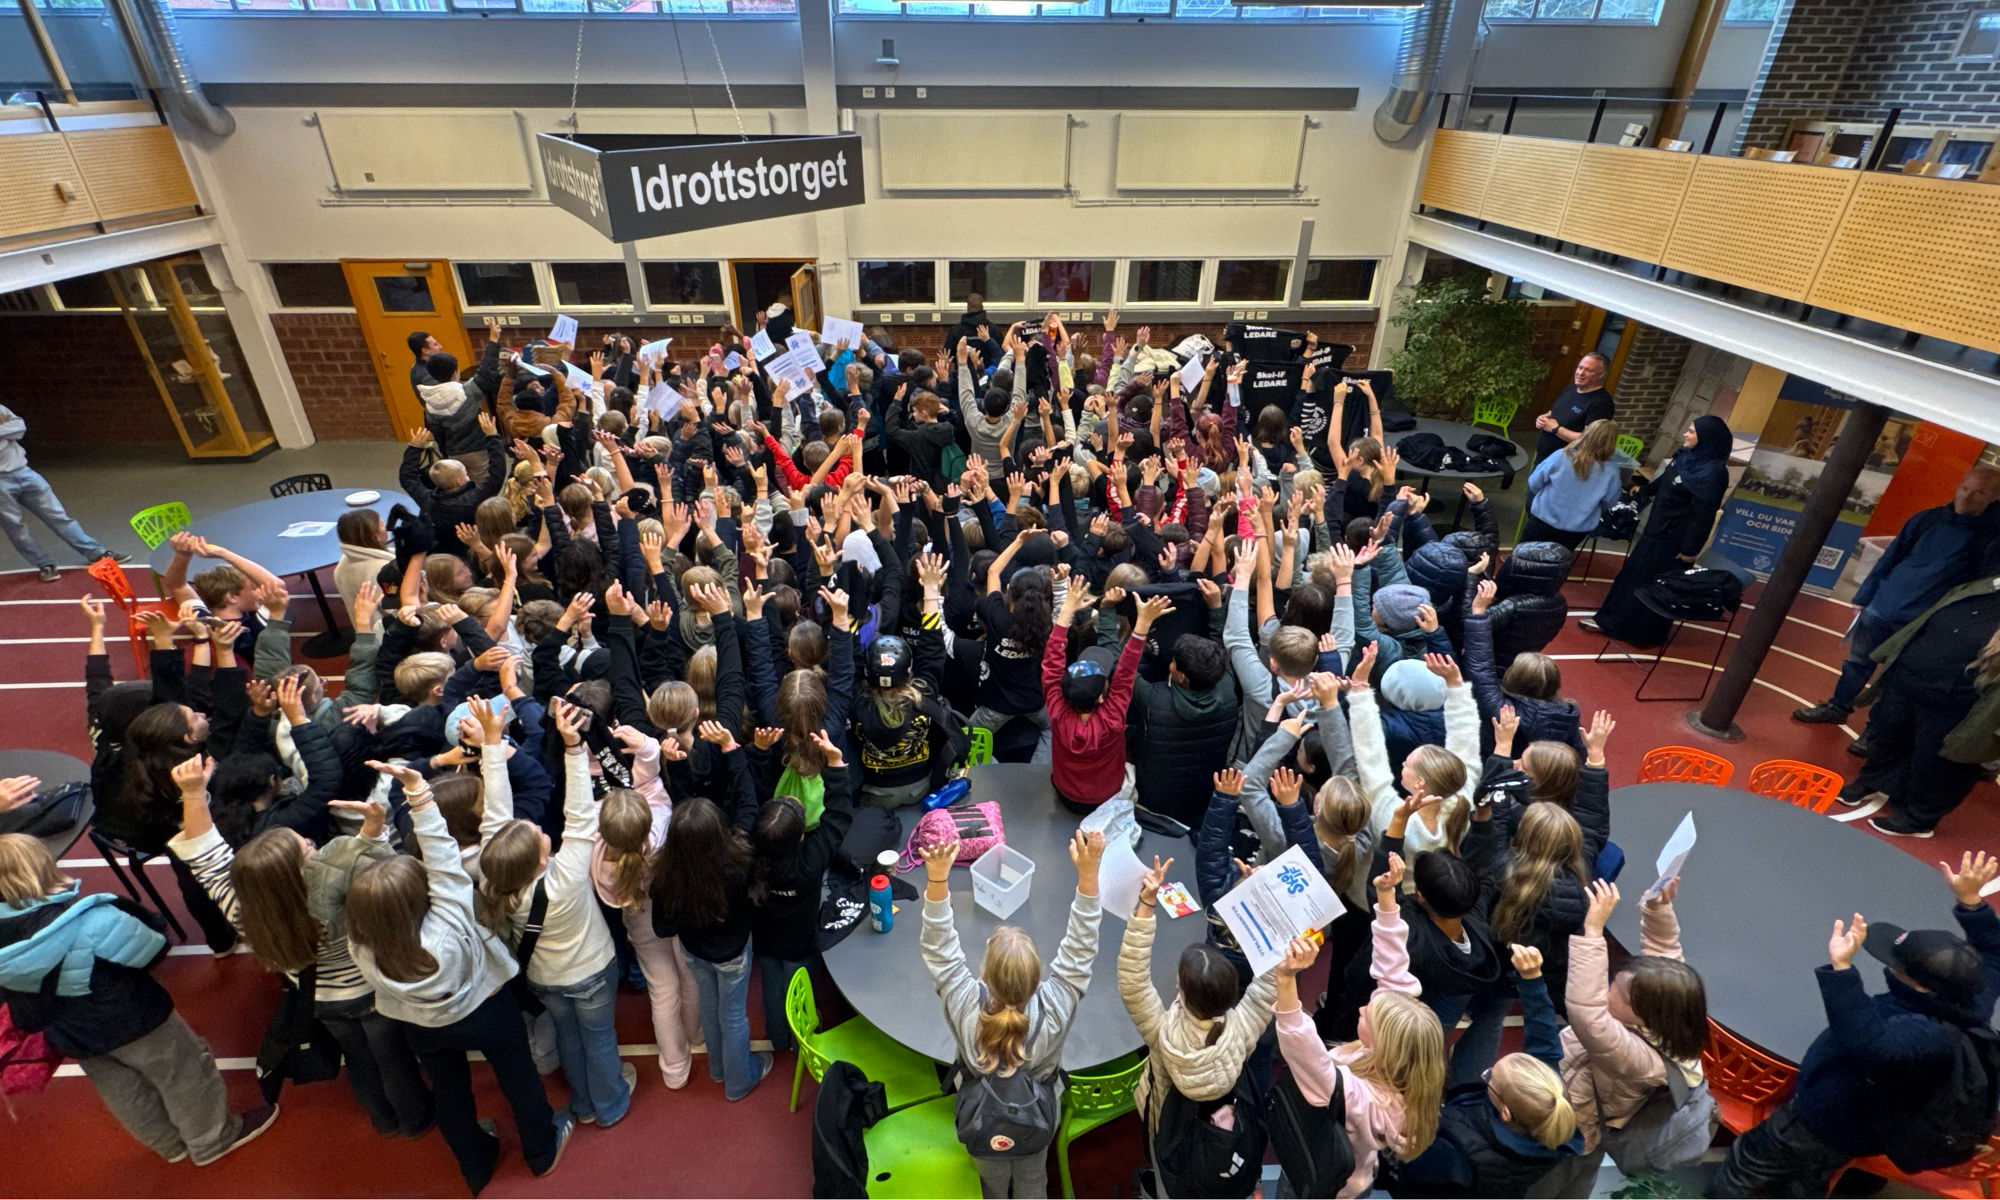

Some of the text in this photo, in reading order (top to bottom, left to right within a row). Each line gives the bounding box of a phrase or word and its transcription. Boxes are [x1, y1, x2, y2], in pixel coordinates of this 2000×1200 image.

[543, 147, 604, 216] Idrottstorget
[630, 151, 848, 213] Idrottstorget
[1256, 371, 1286, 379] Skol-IF
[1253, 379, 1288, 388] LEDARE
[1736, 508, 1755, 518] VILL
[1757, 513, 1773, 521] DU
[1746, 520, 1769, 529] OCH
